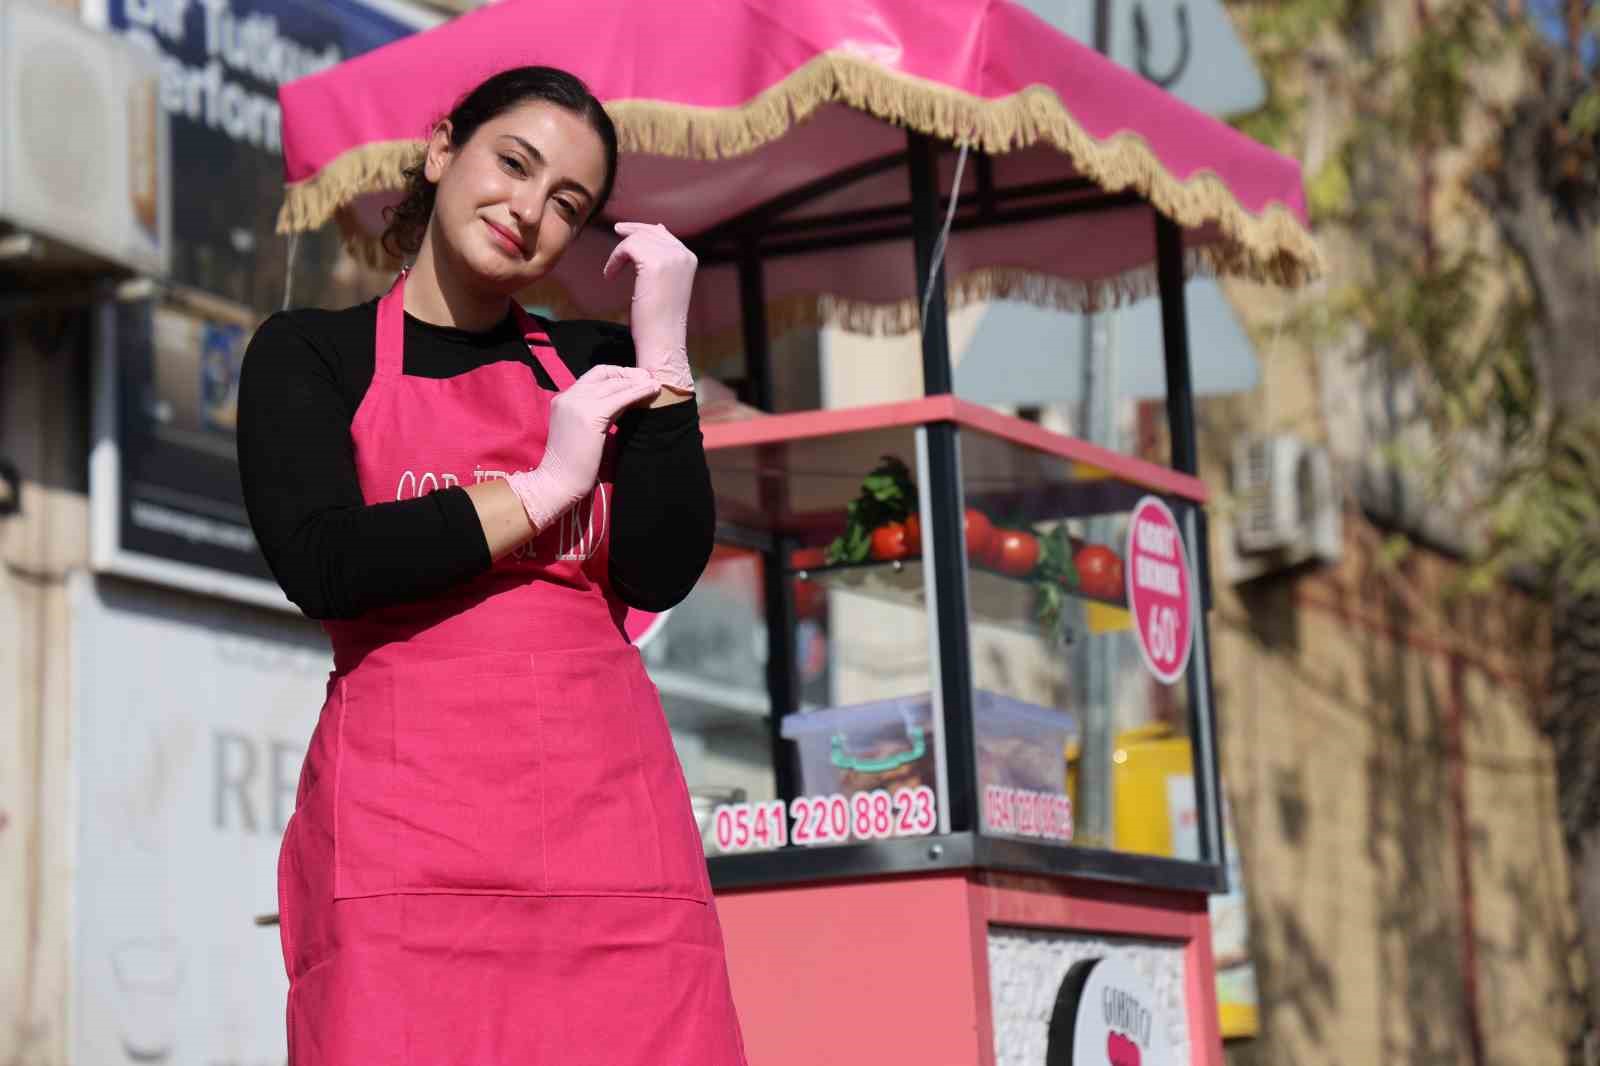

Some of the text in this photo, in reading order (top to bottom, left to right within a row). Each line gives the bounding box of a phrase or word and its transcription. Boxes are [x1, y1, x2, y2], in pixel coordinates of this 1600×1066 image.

[714, 787, 936, 850] 0541 220 88 23
